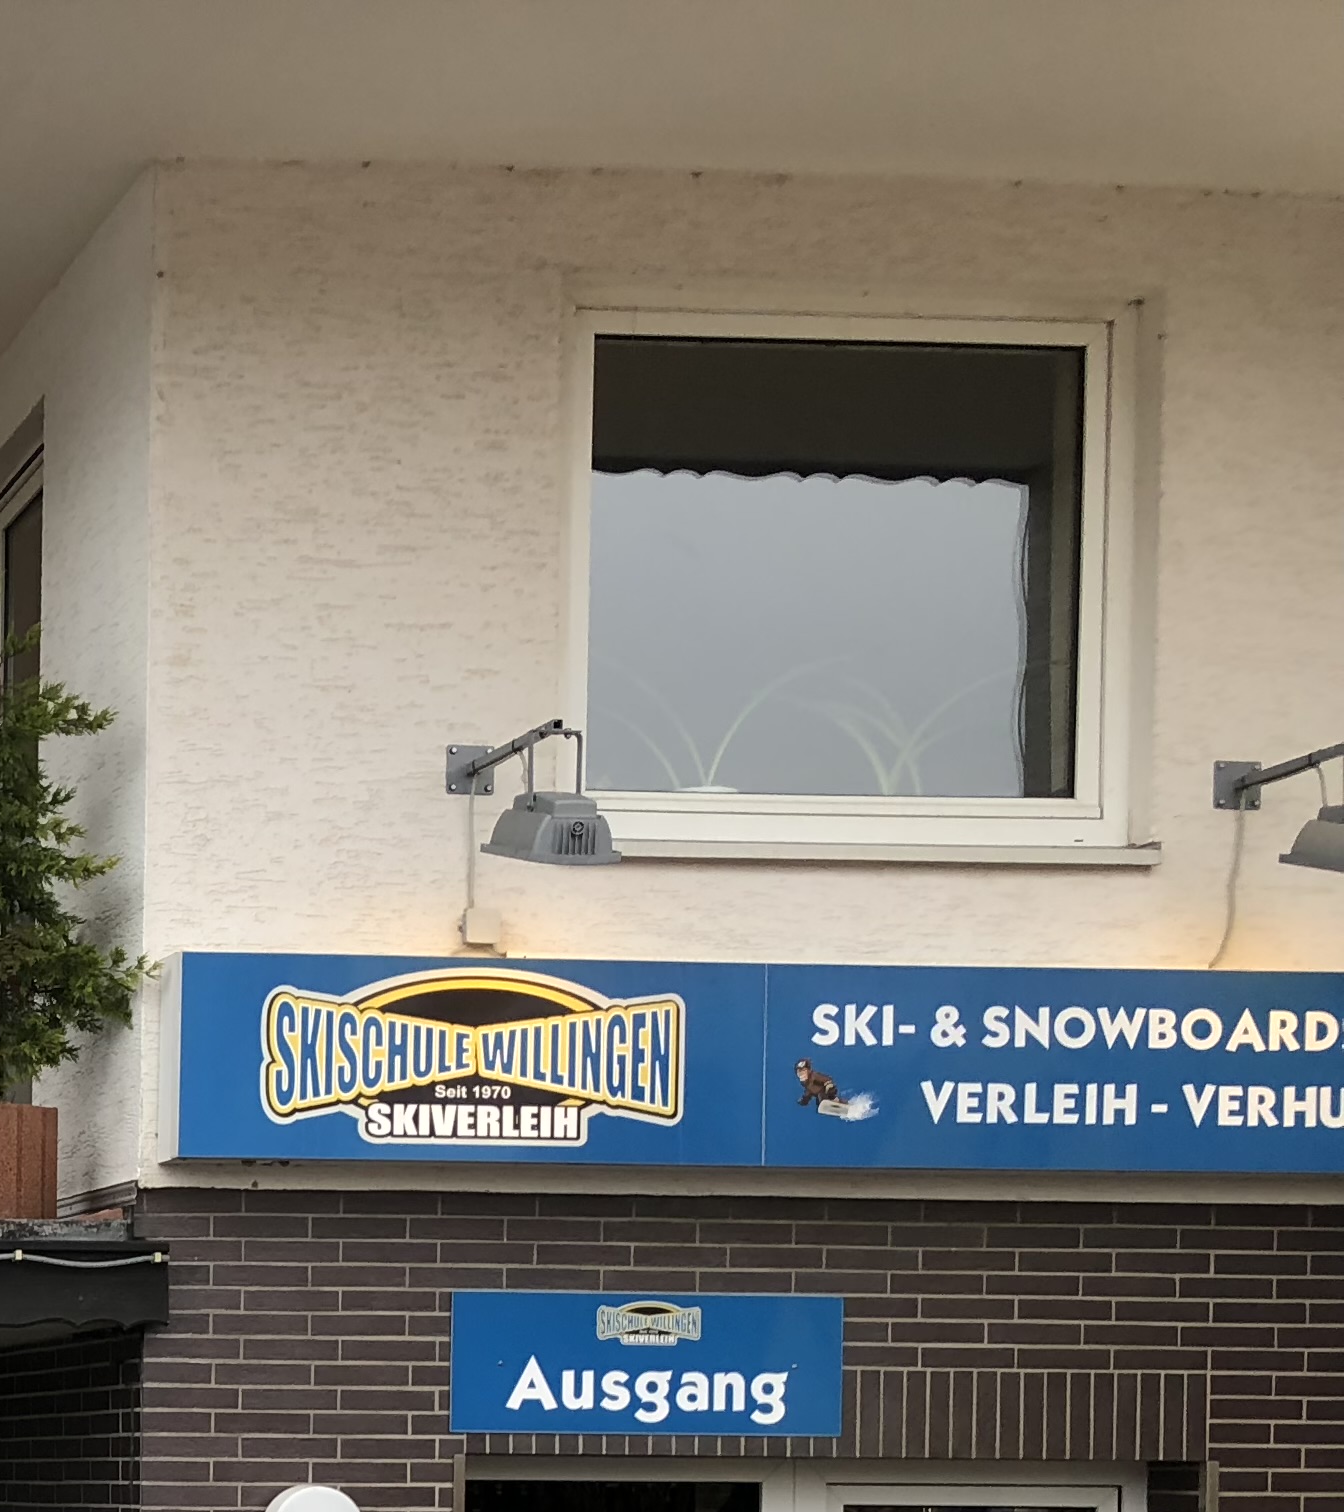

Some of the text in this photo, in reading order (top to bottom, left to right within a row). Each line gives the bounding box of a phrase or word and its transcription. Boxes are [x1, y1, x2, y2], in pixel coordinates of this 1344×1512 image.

[811, 1003, 1344, 1053] SKI- & SNOWBOARD
[275, 1000, 671, 1108] SKISCHULE WILLINGEN
[434, 1084, 512, 1100] Seit 1970
[920, 1080, 1139, 1126] VERLEIH
[1182, 1083, 1344, 1129] VERHU
[368, 1103, 579, 1139] SKIVERLEIH
[600, 1309, 698, 1336] SKISCHULE WILLINGEN
[505, 1355, 791, 1425] Ausgang
